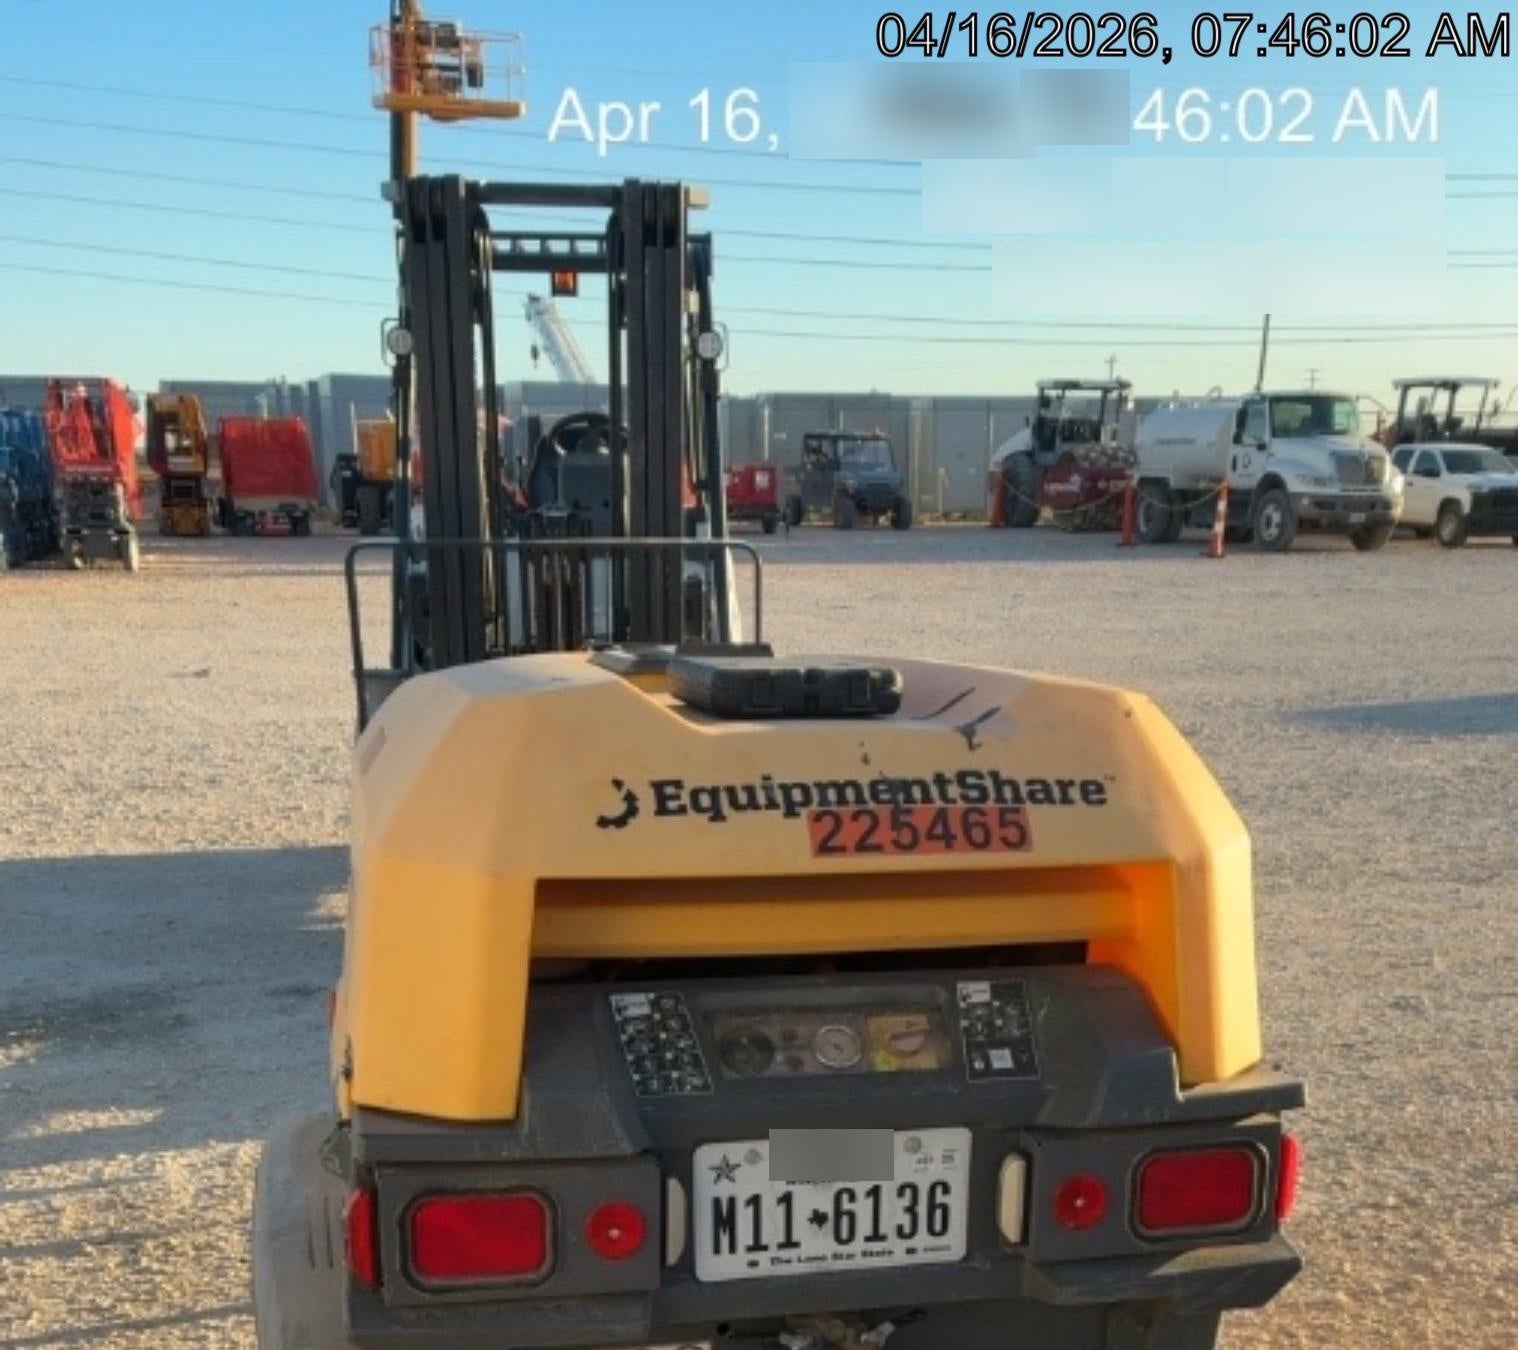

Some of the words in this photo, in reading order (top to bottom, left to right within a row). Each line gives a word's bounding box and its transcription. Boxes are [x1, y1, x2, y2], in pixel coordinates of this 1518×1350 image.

[649, 770, 1108, 823] EquipmentShare
[812, 806, 1030, 853] 225465
[712, 1189, 801, 1255] M11
[832, 1180, 951, 1246] 6136
